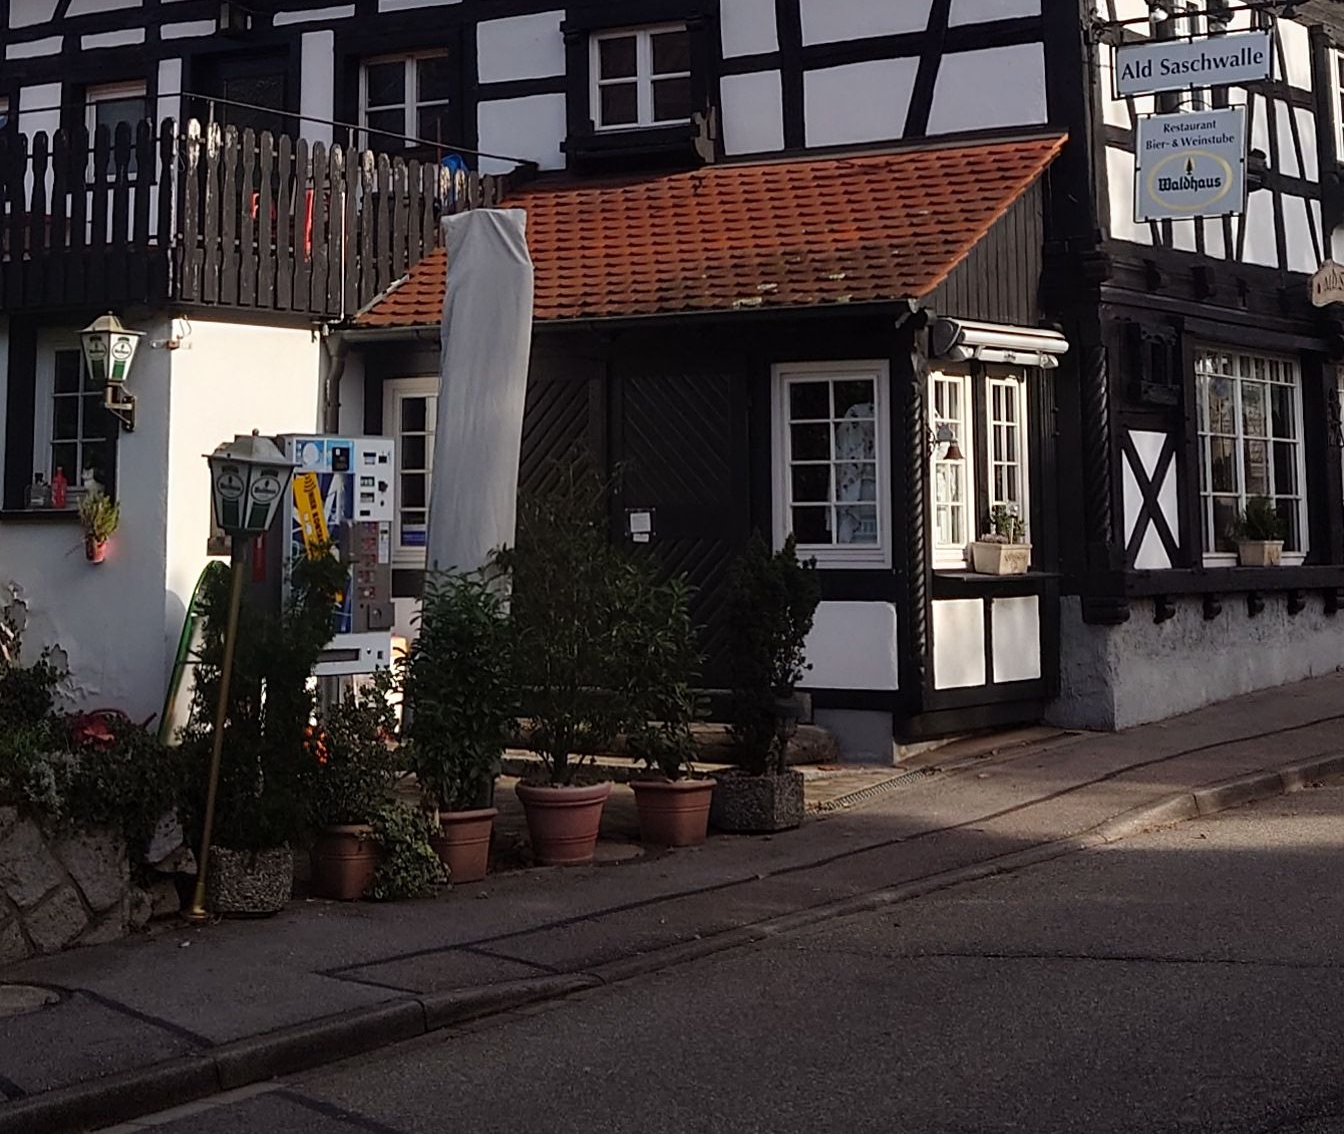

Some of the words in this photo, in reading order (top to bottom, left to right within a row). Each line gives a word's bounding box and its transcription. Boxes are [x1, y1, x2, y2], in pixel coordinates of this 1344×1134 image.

[1121, 59, 1152, 81] Ald
[1160, 47, 1264, 77] Saschwalle
[1163, 120, 1216, 134] Restaurant
[1146, 140, 1170, 150] Bier-
[1171, 138, 1179, 148] &
[1181, 133, 1235, 147] Weinstube
[1158, 176, 1222, 192] Waldhaus
